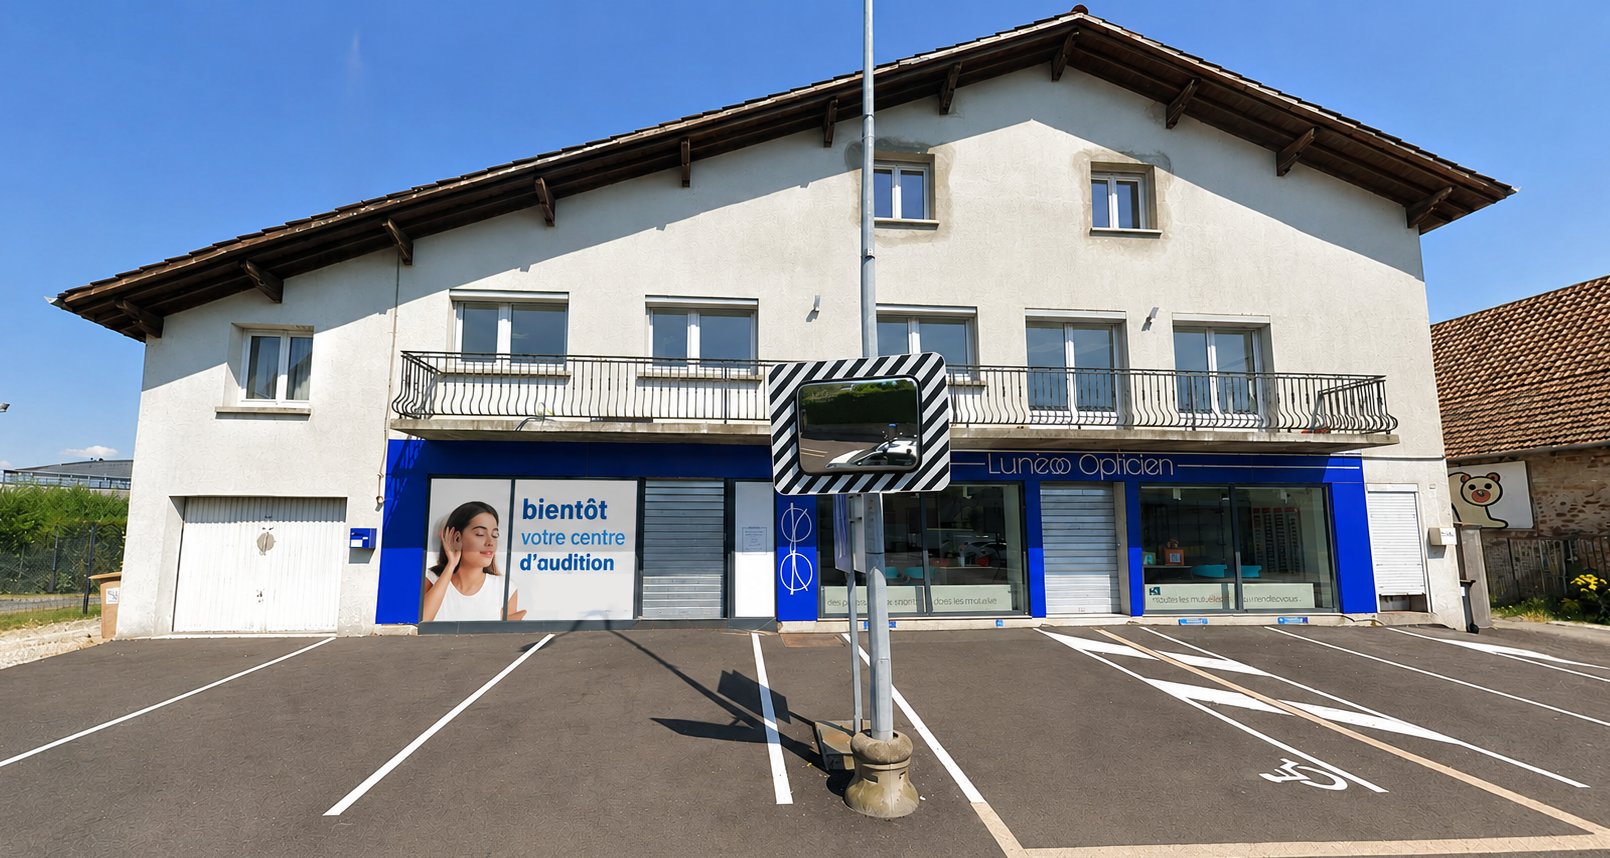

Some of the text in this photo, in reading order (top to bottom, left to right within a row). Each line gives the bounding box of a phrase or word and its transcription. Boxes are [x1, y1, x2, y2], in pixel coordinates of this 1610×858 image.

[1079, 453, 1174, 481] Opticien
[522, 498, 608, 520] bientôt
[521, 529, 625, 545] votre centre
